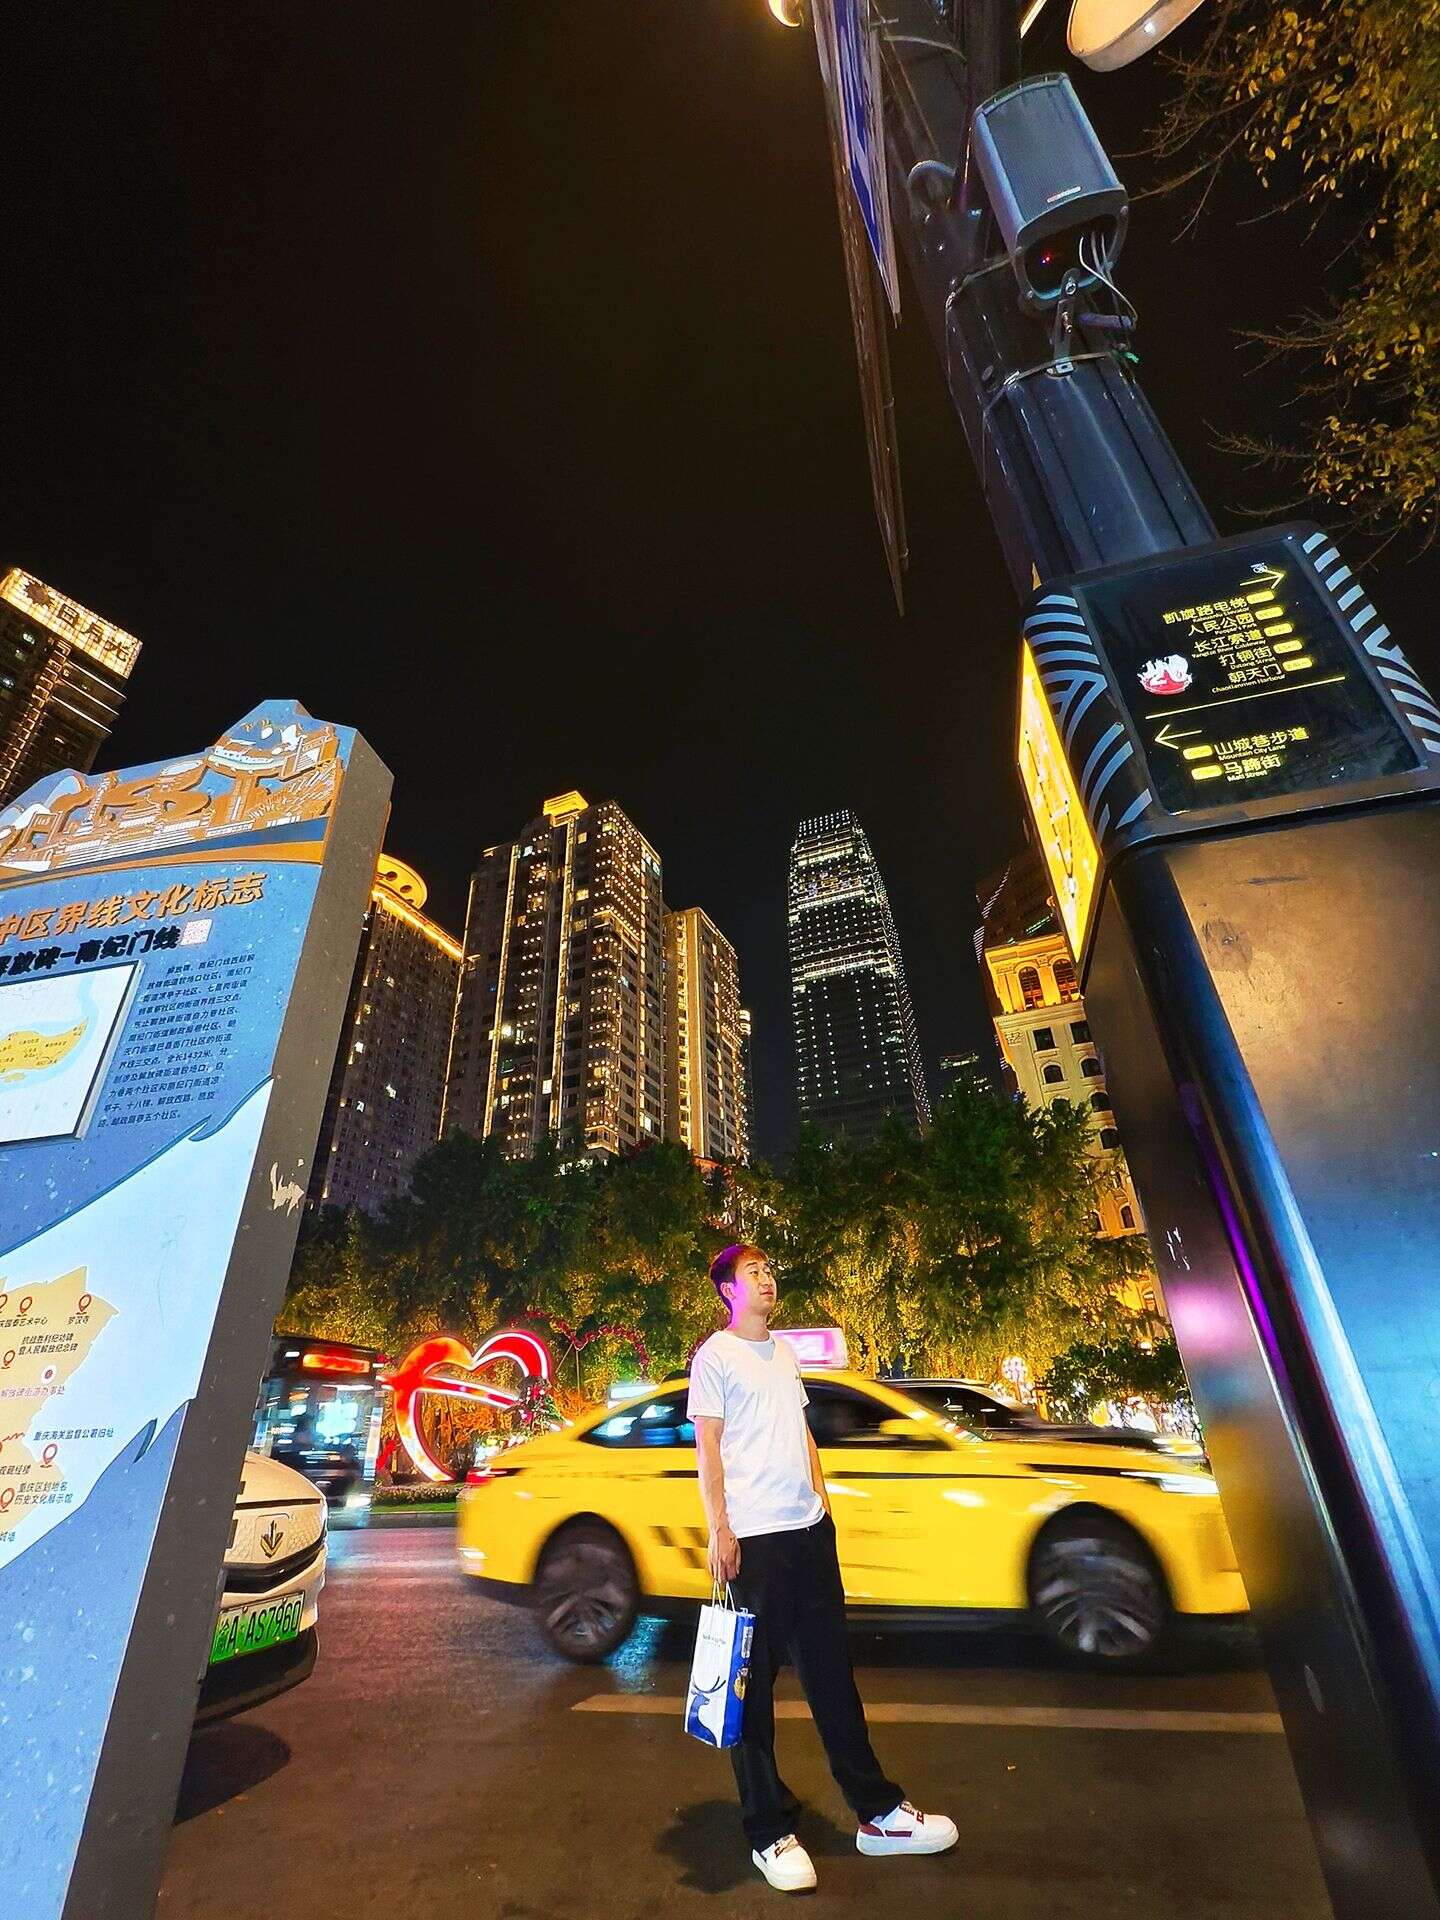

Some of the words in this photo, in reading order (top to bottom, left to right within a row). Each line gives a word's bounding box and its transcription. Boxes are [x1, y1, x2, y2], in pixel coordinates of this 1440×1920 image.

[1163, 597, 1248, 625] 凯旋路电梯
[58, 603, 130, 662] 日月光
[1188, 613, 1254, 636] 人民公园
[1194, 629, 1264, 652] 长江索道
[1219, 646, 1273, 667] 打铜街
[1228, 663, 1282, 684] 朝天门
[1257, 674, 1286, 686] Harbour
[1214, 727, 1309, 756] 山城巷步道
[1218, 751, 1254, 762] Mountain
[1223, 754, 1281, 775] 马蹄街
[0, 872, 268, 945] 中区界线文化标志
